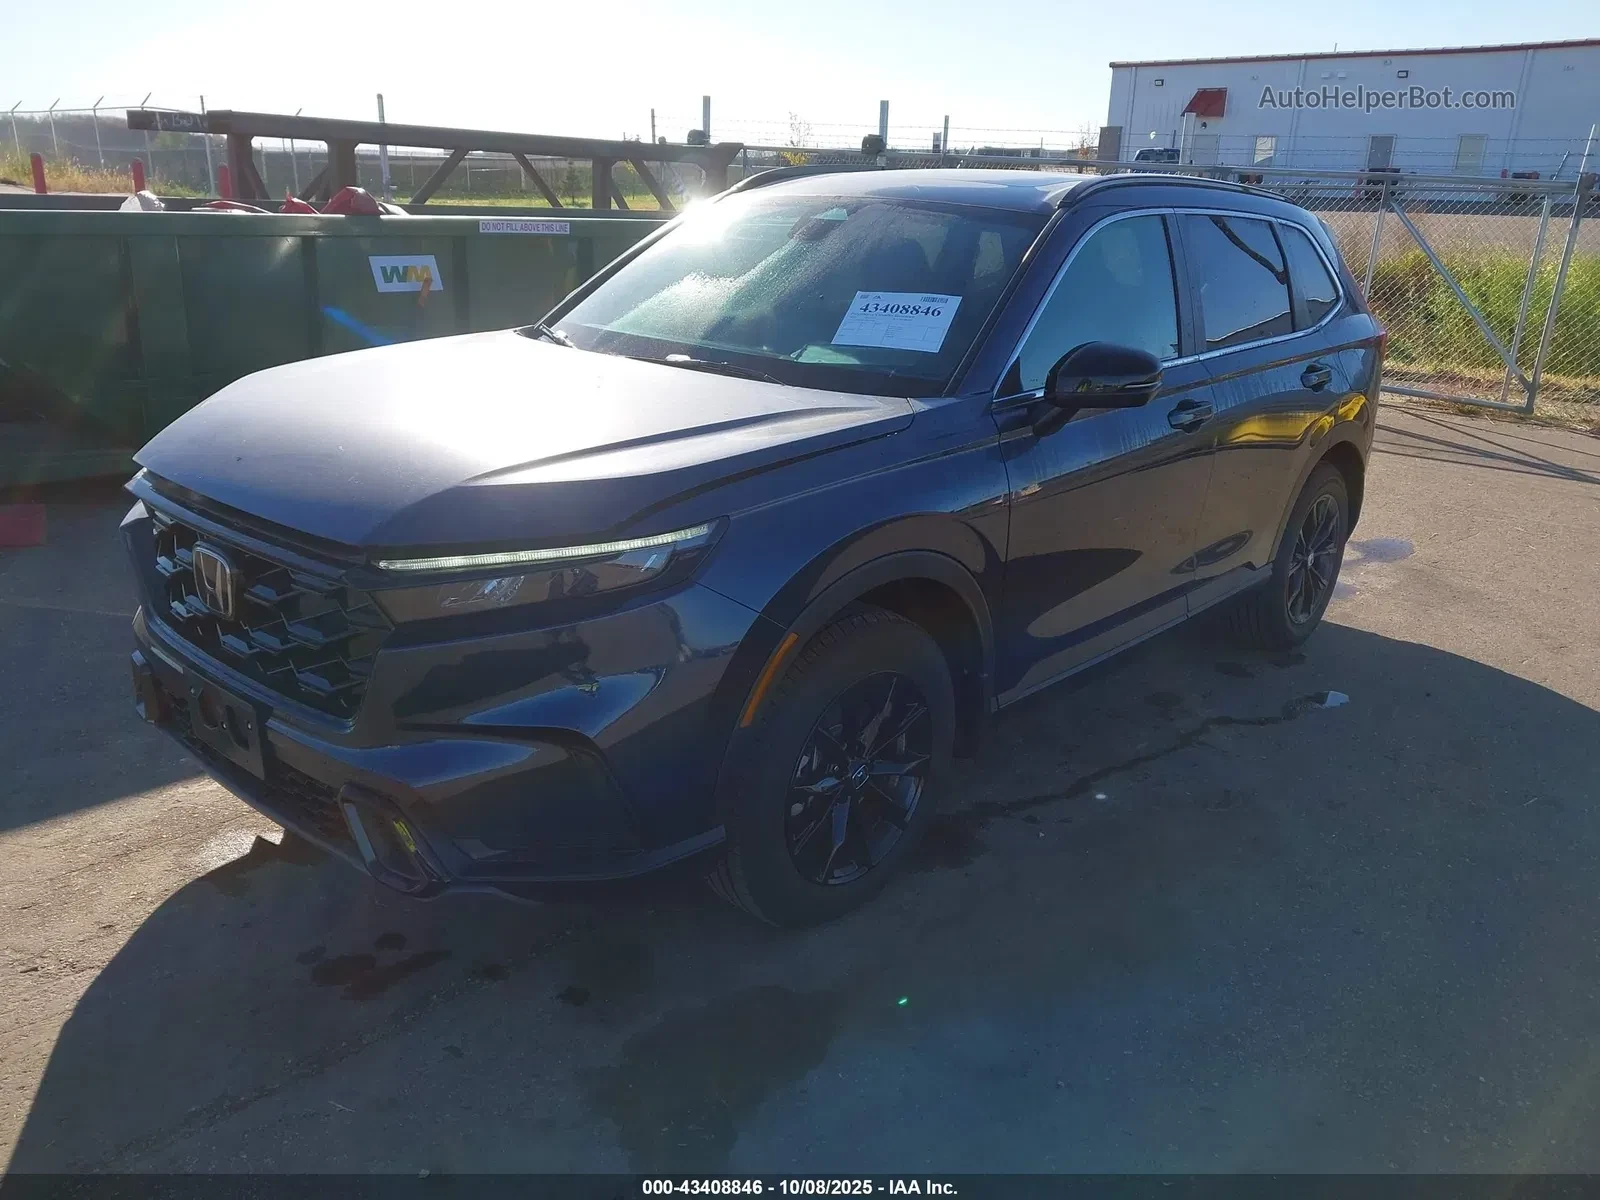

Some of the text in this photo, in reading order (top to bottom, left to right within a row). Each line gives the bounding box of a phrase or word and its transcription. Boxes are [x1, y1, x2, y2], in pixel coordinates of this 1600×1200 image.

[481, 222, 568, 232] DO NOT FILL ABOVE THIS LINE
[380, 265, 433, 284] WM
[859, 303, 944, 317] 43408846
